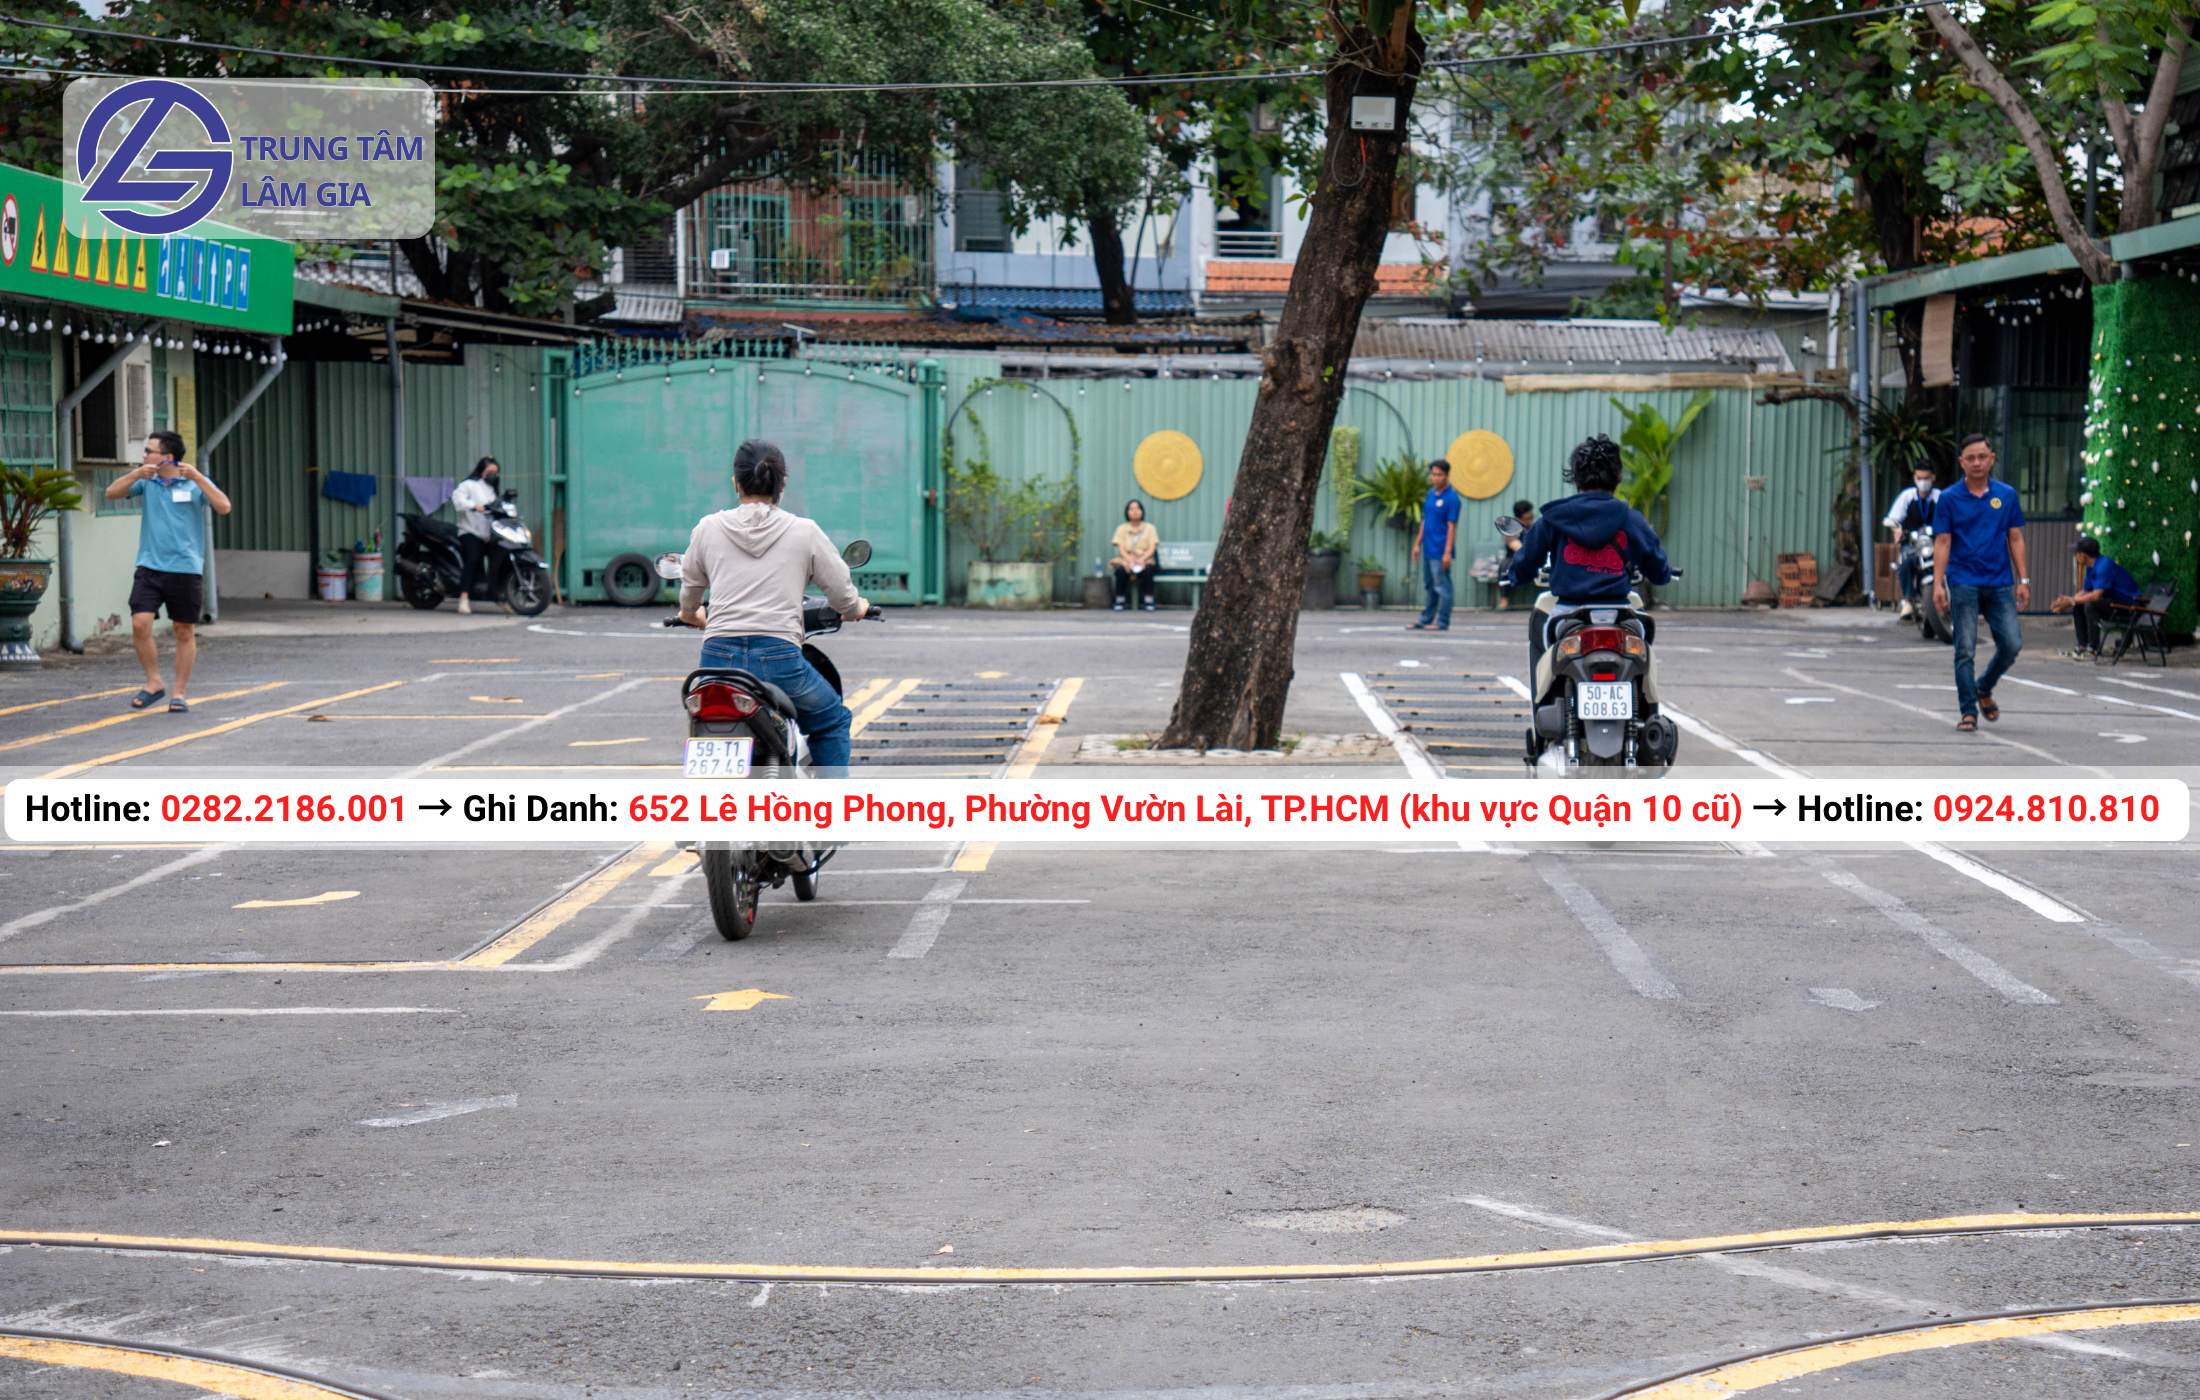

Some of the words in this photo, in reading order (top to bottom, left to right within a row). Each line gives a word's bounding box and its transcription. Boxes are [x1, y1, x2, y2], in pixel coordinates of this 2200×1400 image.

[1586, 686, 1624, 700] 50-AC
[1583, 702, 1628, 716] 608.63
[696, 741, 740, 757] 59-T1
[687, 759, 746, 775] 267.46
